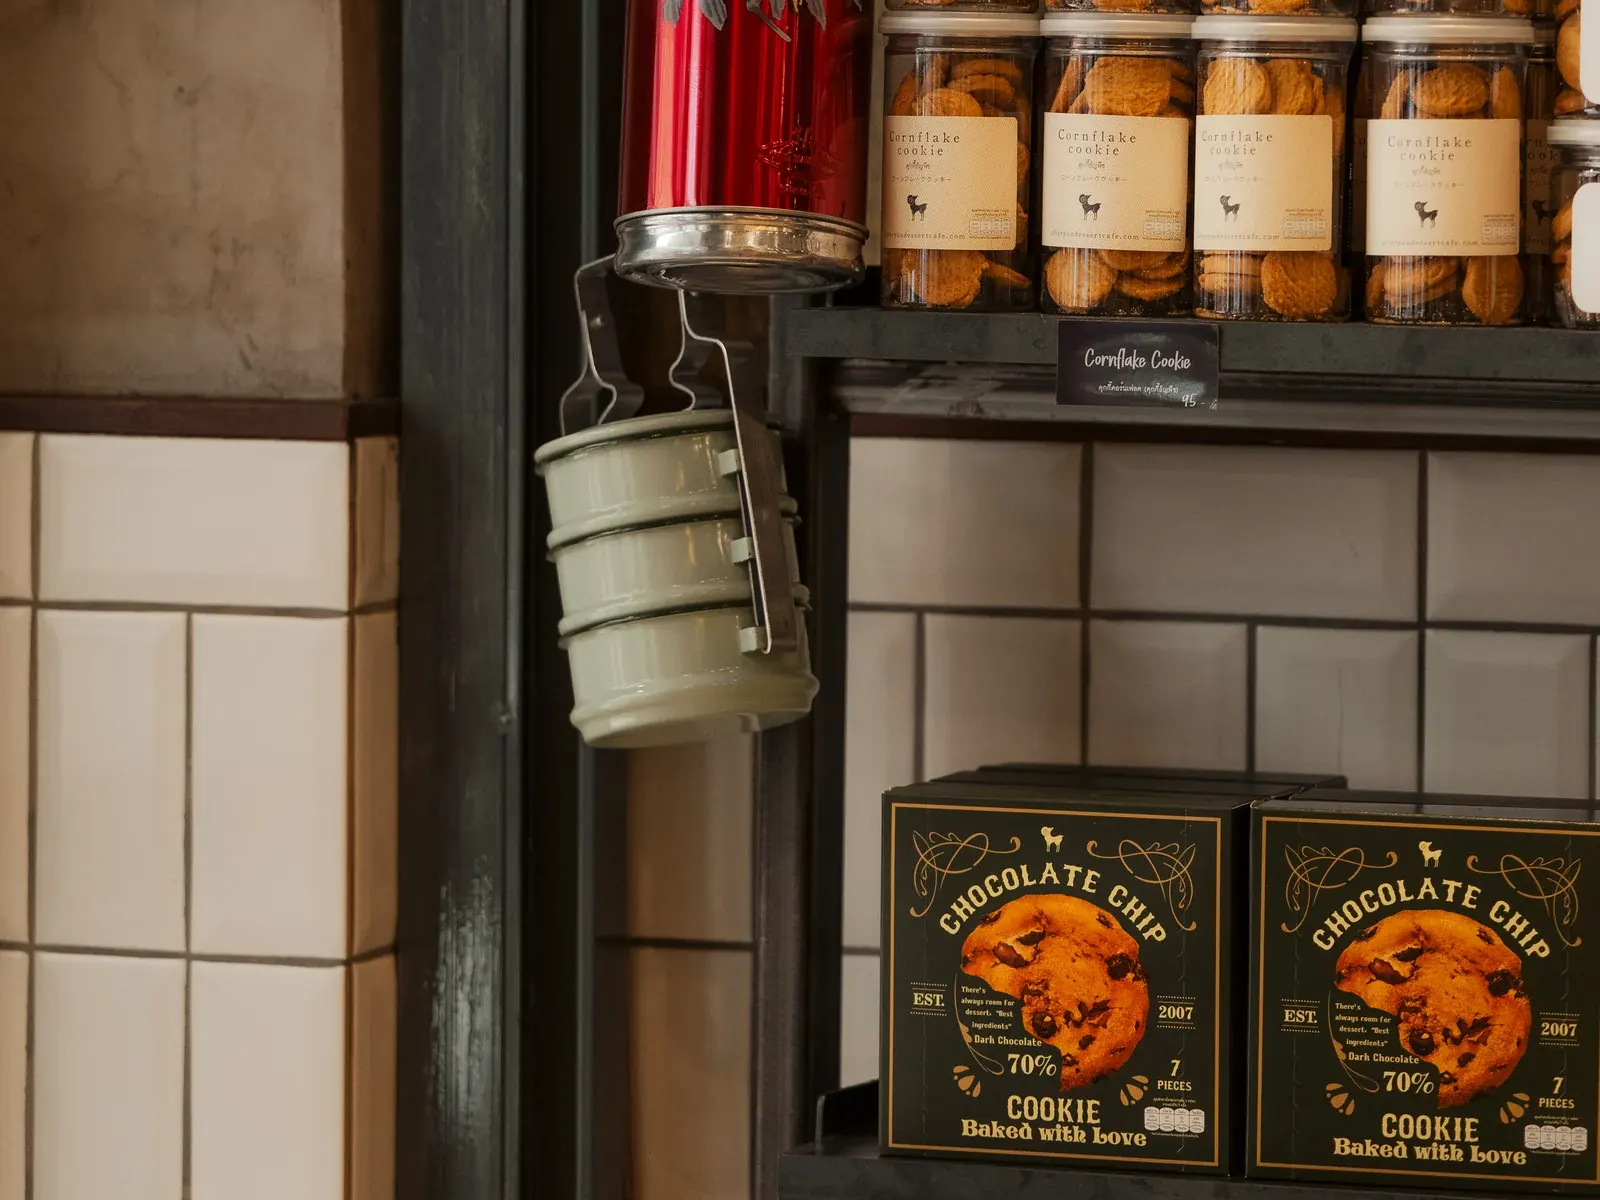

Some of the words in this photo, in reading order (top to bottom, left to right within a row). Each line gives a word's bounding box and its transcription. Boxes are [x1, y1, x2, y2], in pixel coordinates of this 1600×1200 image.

[889, 131, 960, 144] Cornflake
[1058, 129, 1136, 144] Cornflake
[1202, 130, 1273, 142] Cornflake
[1387, 136, 1473, 148] Cornflake
[897, 145, 944, 156] cookie
[1068, 144, 1119, 156] cookie
[1209, 144, 1257, 156] cookie
[1400, 149, 1456, 161] cookie
[1084, 347, 1147, 370] Cornflake
[1151, 349, 1192, 371] Cookie
[939, 862, 1102, 935] CHOCOLATE
[1107, 884, 1167, 943] CHIP
[1312, 877, 1482, 952] CHOCOLATE
[1488, 899, 1550, 960] CHIP
[961, 986, 986, 994] There's
[913, 992, 945, 1007] EST.
[961, 997, 984, 1006] always
[965, 1008, 992, 1016] dessert.
[1158, 1005, 1194, 1020] 2007
[1335, 1003, 1361, 1011] There's
[1283, 1009, 1318, 1024] EST.
[1335, 1014, 1359, 1023] always
[1540, 1022, 1578, 1037] 2007
[974, 1034, 995, 1044] Dark
[997, 1036, 1043, 1047] Chocolate
[1007, 1053, 1057, 1076] 70%
[1348, 1052, 1370, 1061] Dark
[1373, 1053, 1420, 1064] Chocolate
[1170, 1059, 1181, 1077] 7
[1157, 1079, 1192, 1091] PIECES
[1383, 1071, 1435, 1094] 70%
[1552, 1076, 1564, 1094] 7
[1007, 1094, 1101, 1125] COOKIE
[1538, 1097, 1575, 1109] PIECES
[961, 1119, 1033, 1140] Baked
[1038, 1123, 1087, 1144] with
[1092, 1126, 1148, 1147] Love
[1381, 1112, 1480, 1143] COOKIE
[1333, 1138, 1408, 1159] Baked
[1413, 1142, 1464, 1164] with
[1469, 1146, 1527, 1165] Love
